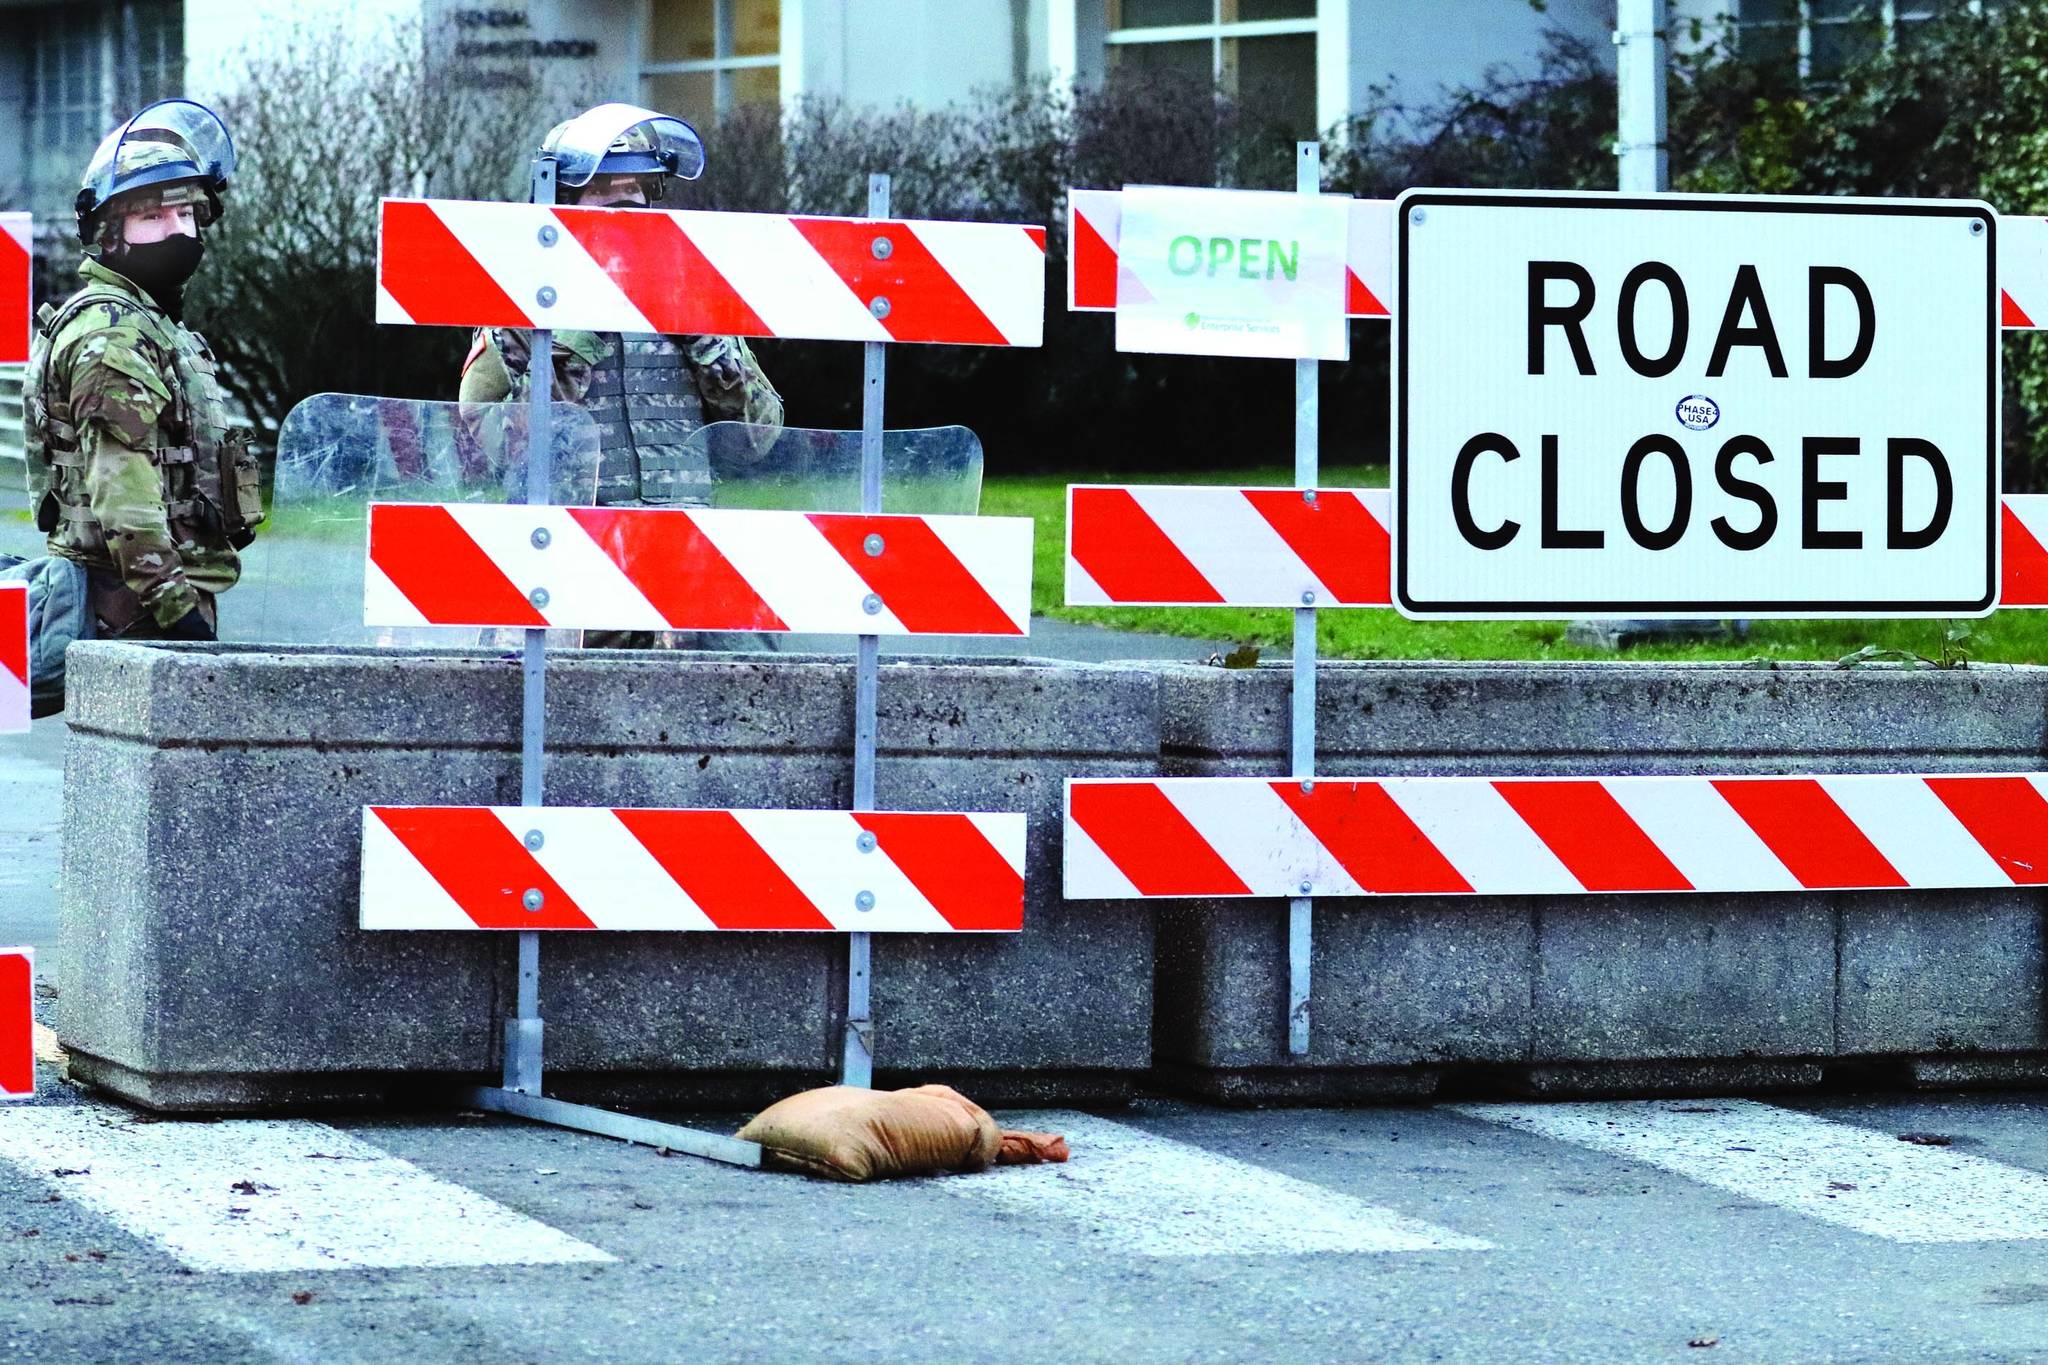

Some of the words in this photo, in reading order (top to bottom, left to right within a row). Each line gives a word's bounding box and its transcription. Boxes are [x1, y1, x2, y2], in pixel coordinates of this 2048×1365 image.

[1168, 235, 1299, 281] OPEN
[1528, 261, 1876, 379] ROAD
[1452, 433, 1953, 551] CLOSED
